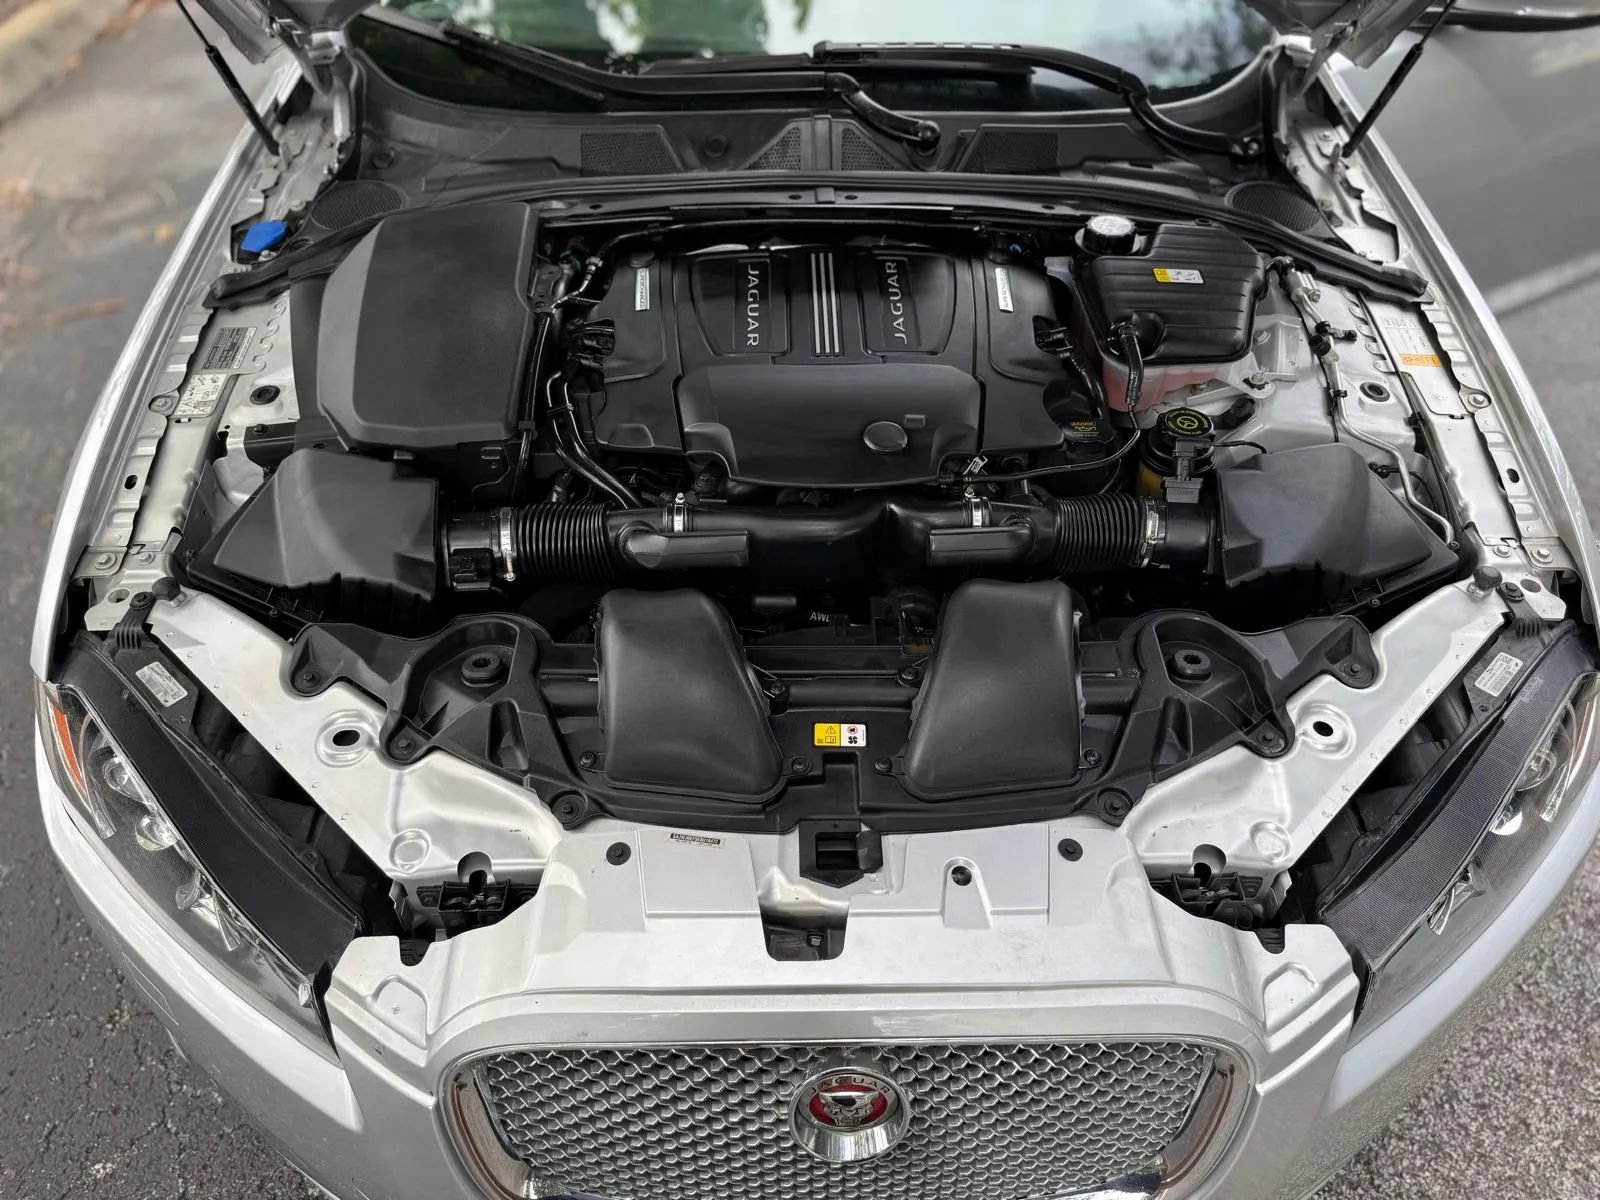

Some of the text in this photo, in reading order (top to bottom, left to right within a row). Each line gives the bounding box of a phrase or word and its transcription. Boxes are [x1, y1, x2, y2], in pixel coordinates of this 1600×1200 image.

[746, 263, 760, 347] JAGUAR
[885, 261, 908, 345] JAGUAR
[811, 1076, 890, 1095] JAGUAR
